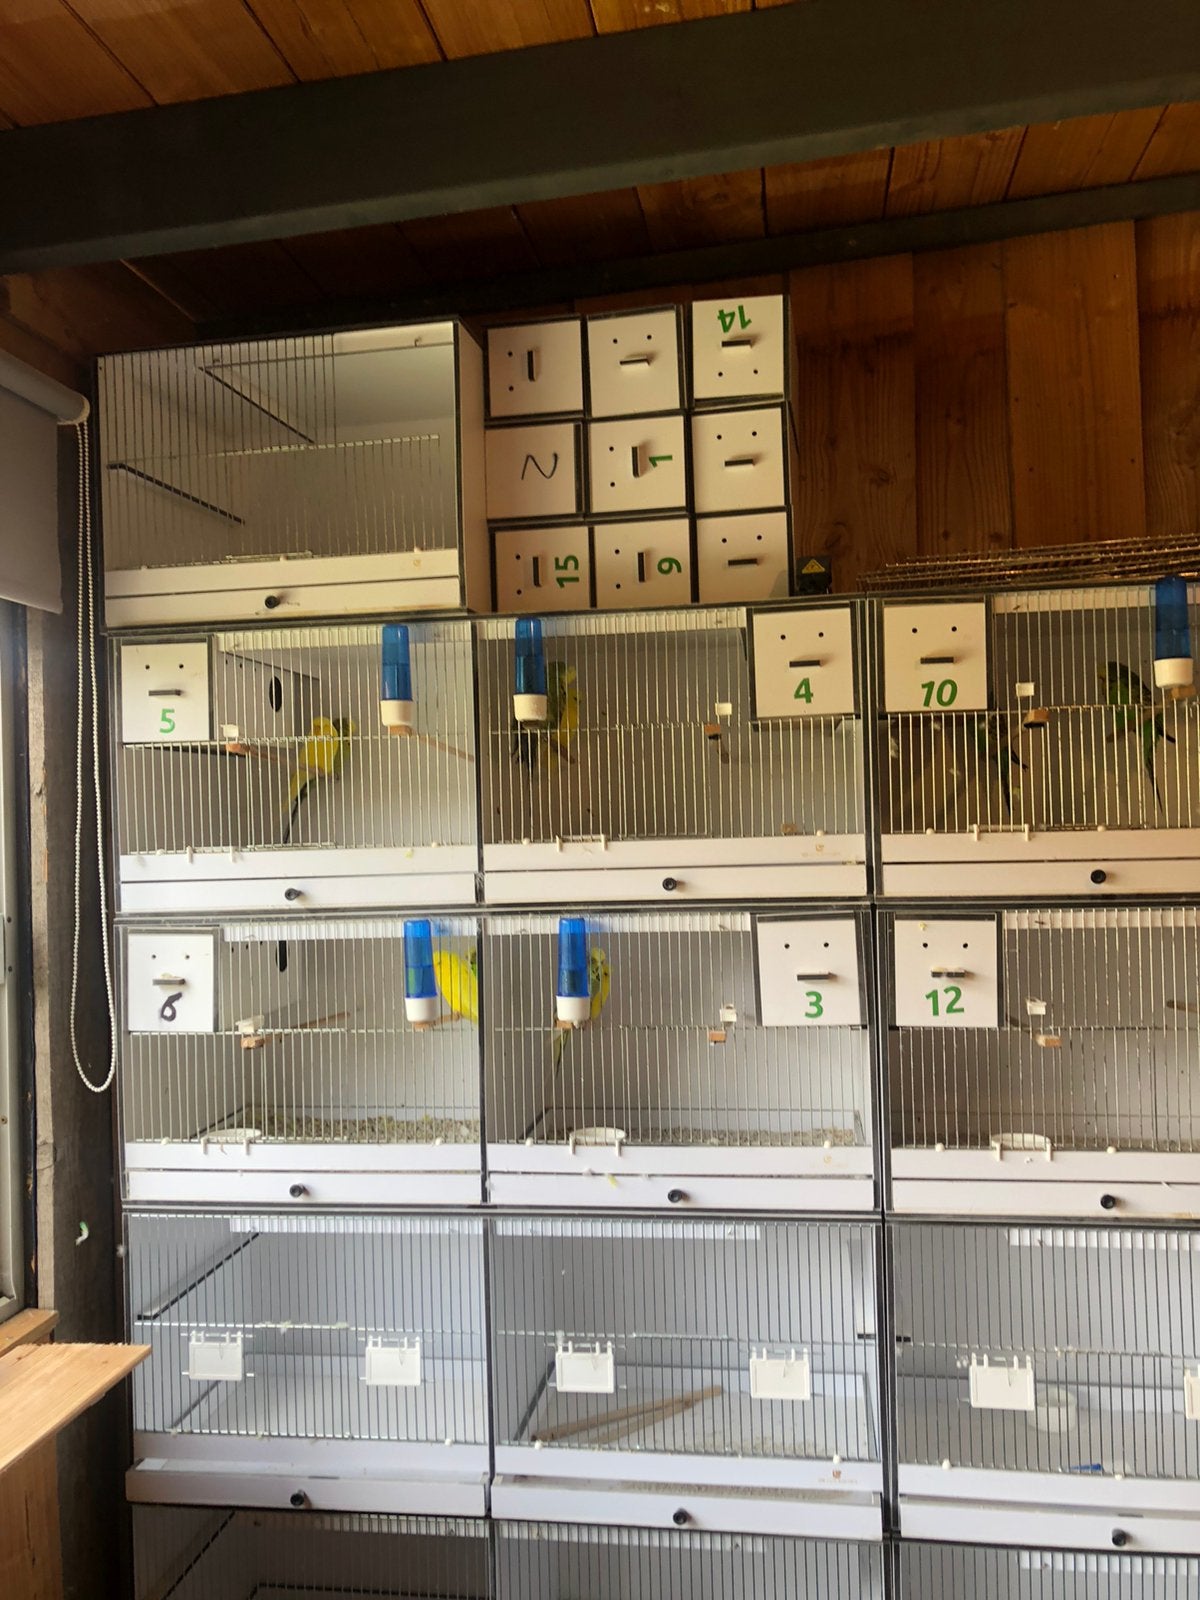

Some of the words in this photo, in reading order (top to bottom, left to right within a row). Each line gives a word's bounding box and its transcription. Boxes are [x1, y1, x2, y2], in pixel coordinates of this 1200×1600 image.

[717, 305, 752, 333] 14
[648, 454, 674, 469] 1
[554, 554, 580, 588] 15
[793, 678, 815, 705] 4
[921, 678, 959, 708] 10
[159, 708, 176, 734] 5
[160, 992, 183, 1022] 6
[804, 990, 824, 1020] 3
[925, 986, 965, 1017] 12
